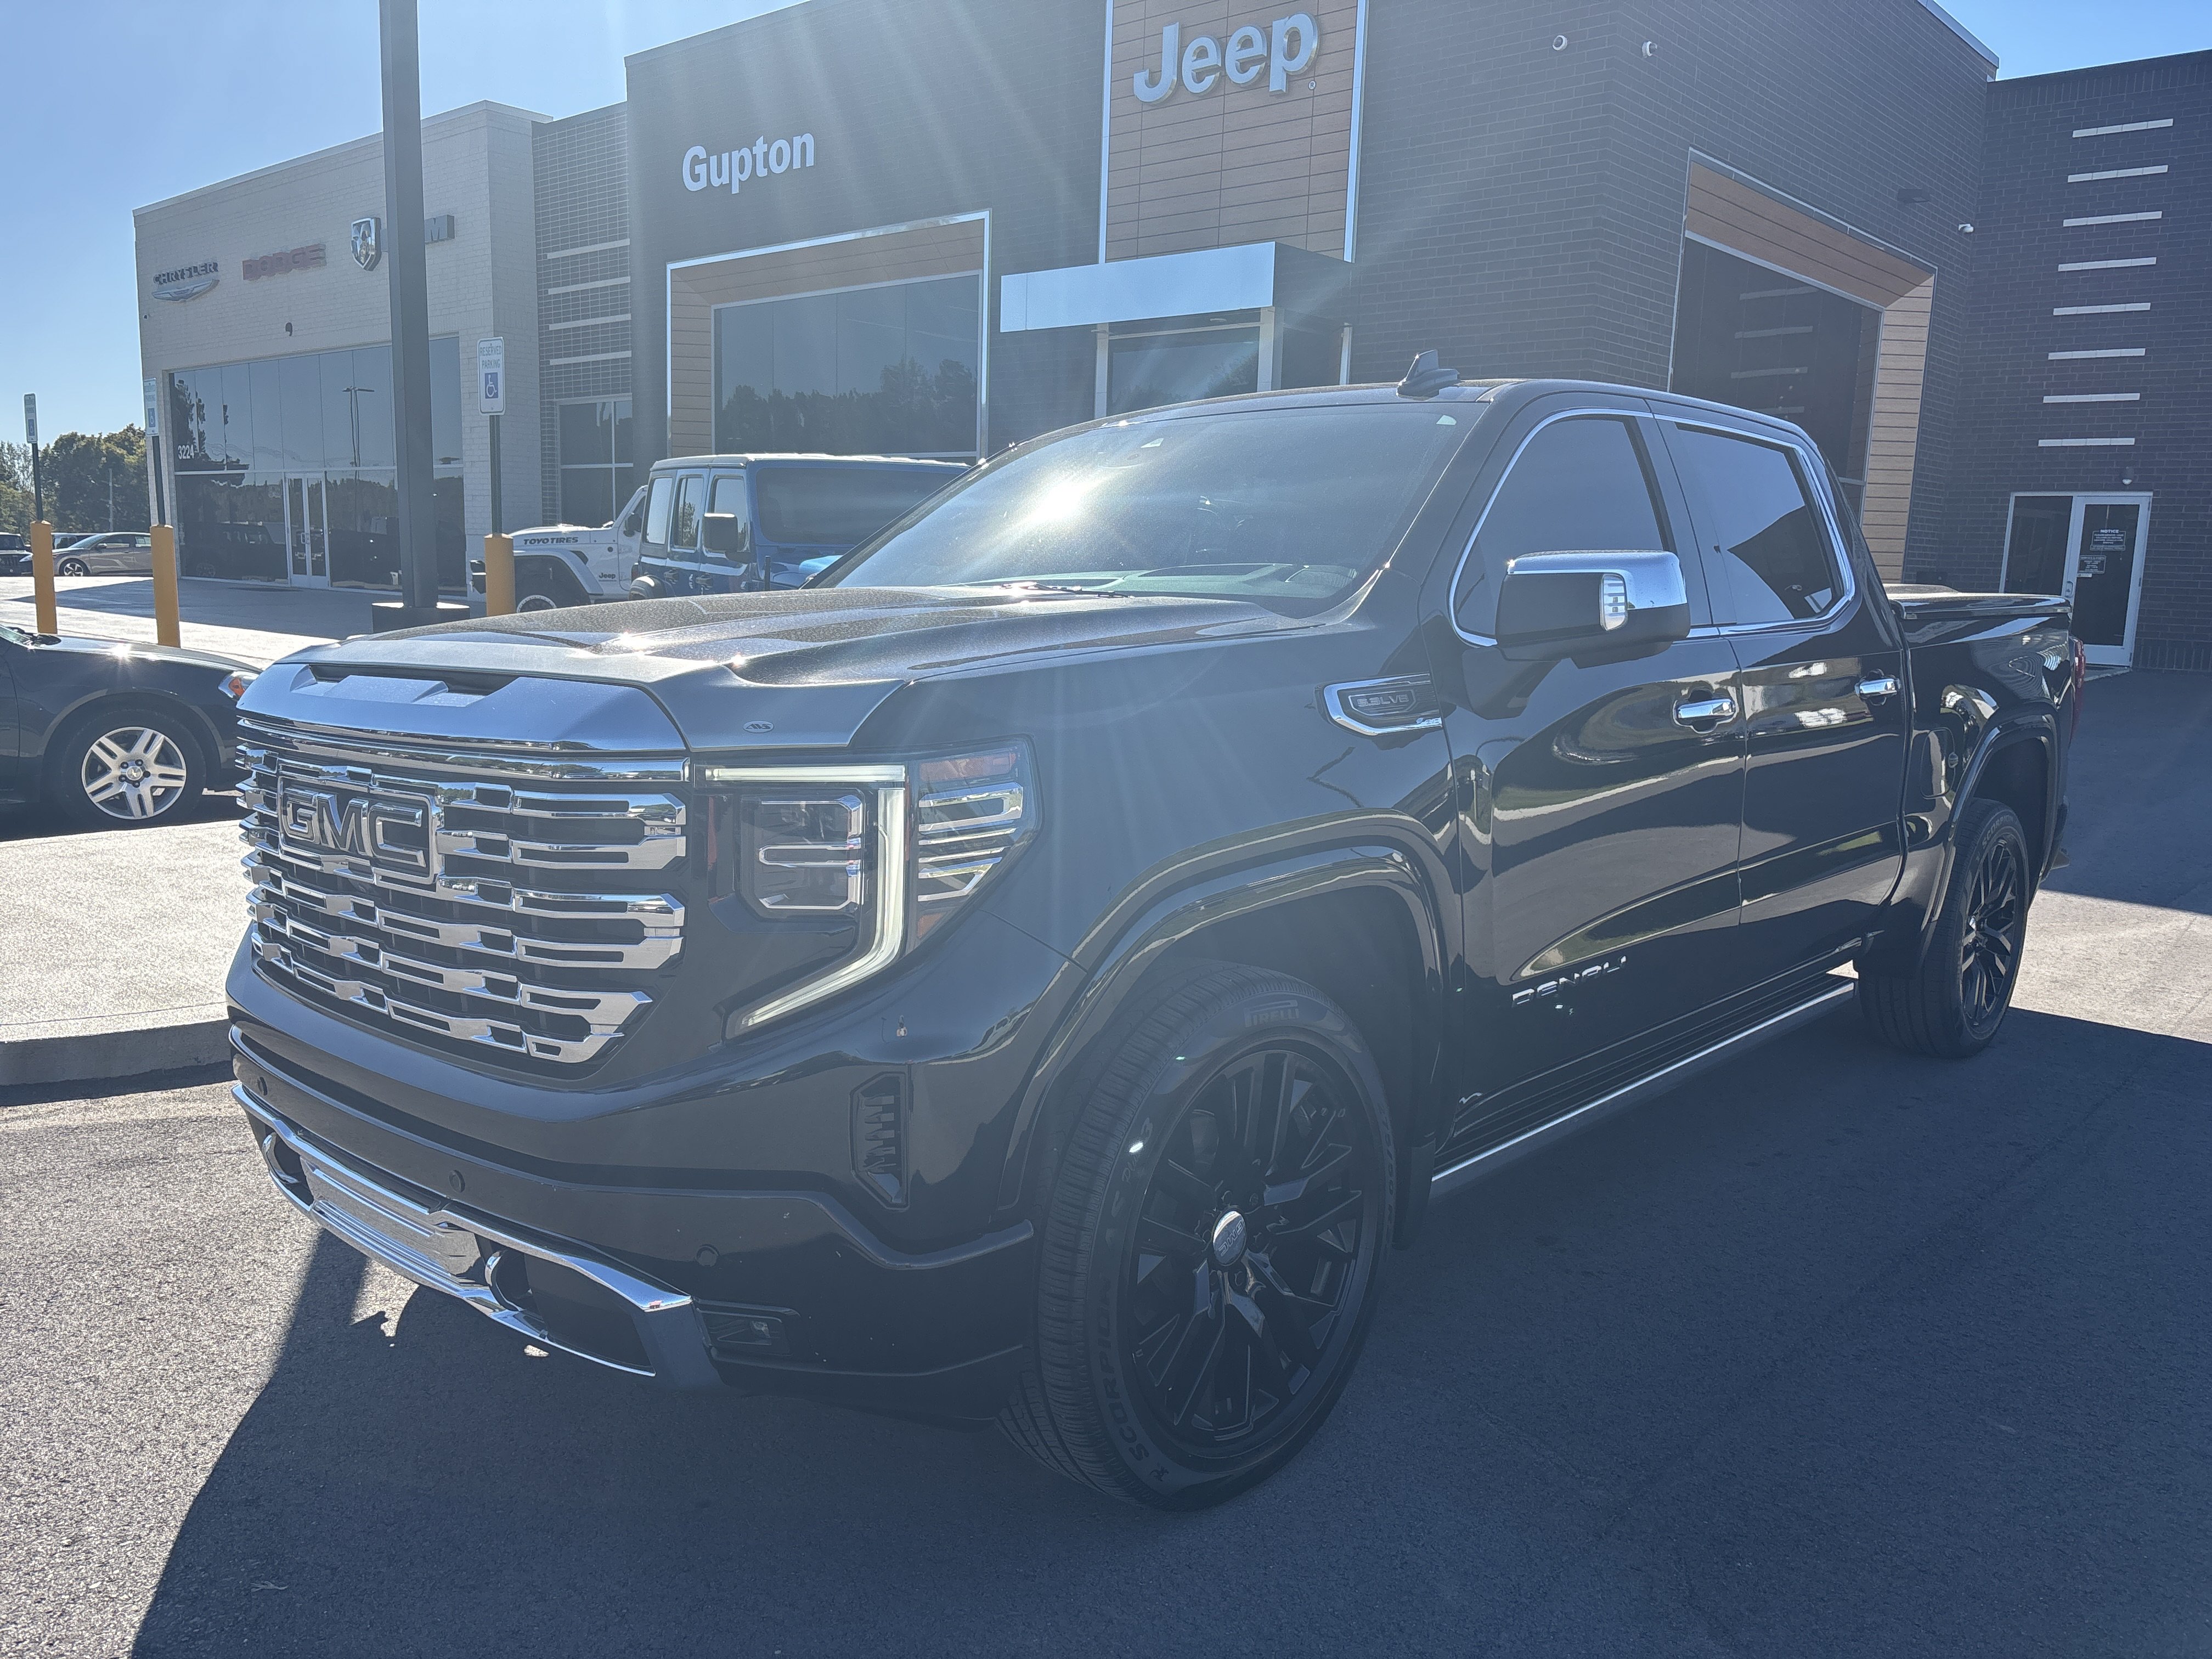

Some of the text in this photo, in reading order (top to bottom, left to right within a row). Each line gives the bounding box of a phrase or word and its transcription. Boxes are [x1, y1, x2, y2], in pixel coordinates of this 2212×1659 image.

[1132, 11, 1321, 105] Jeep
[682, 131, 816, 195] Gupton
[153, 262, 219, 285] CHRYSLER
[242, 243, 327, 281] DODGE
[479, 345, 502, 356] RESERVED
[481, 358, 501, 369] PARKING
[178, 444, 194, 460] 3224
[550, 536, 579, 544] TIRES
[281, 785, 427, 868] GMC
[1511, 955, 1627, 1008] DENALI
[1244, 999, 1300, 1028] PIRELLI
[1218, 1220, 1244, 1257] GMC
